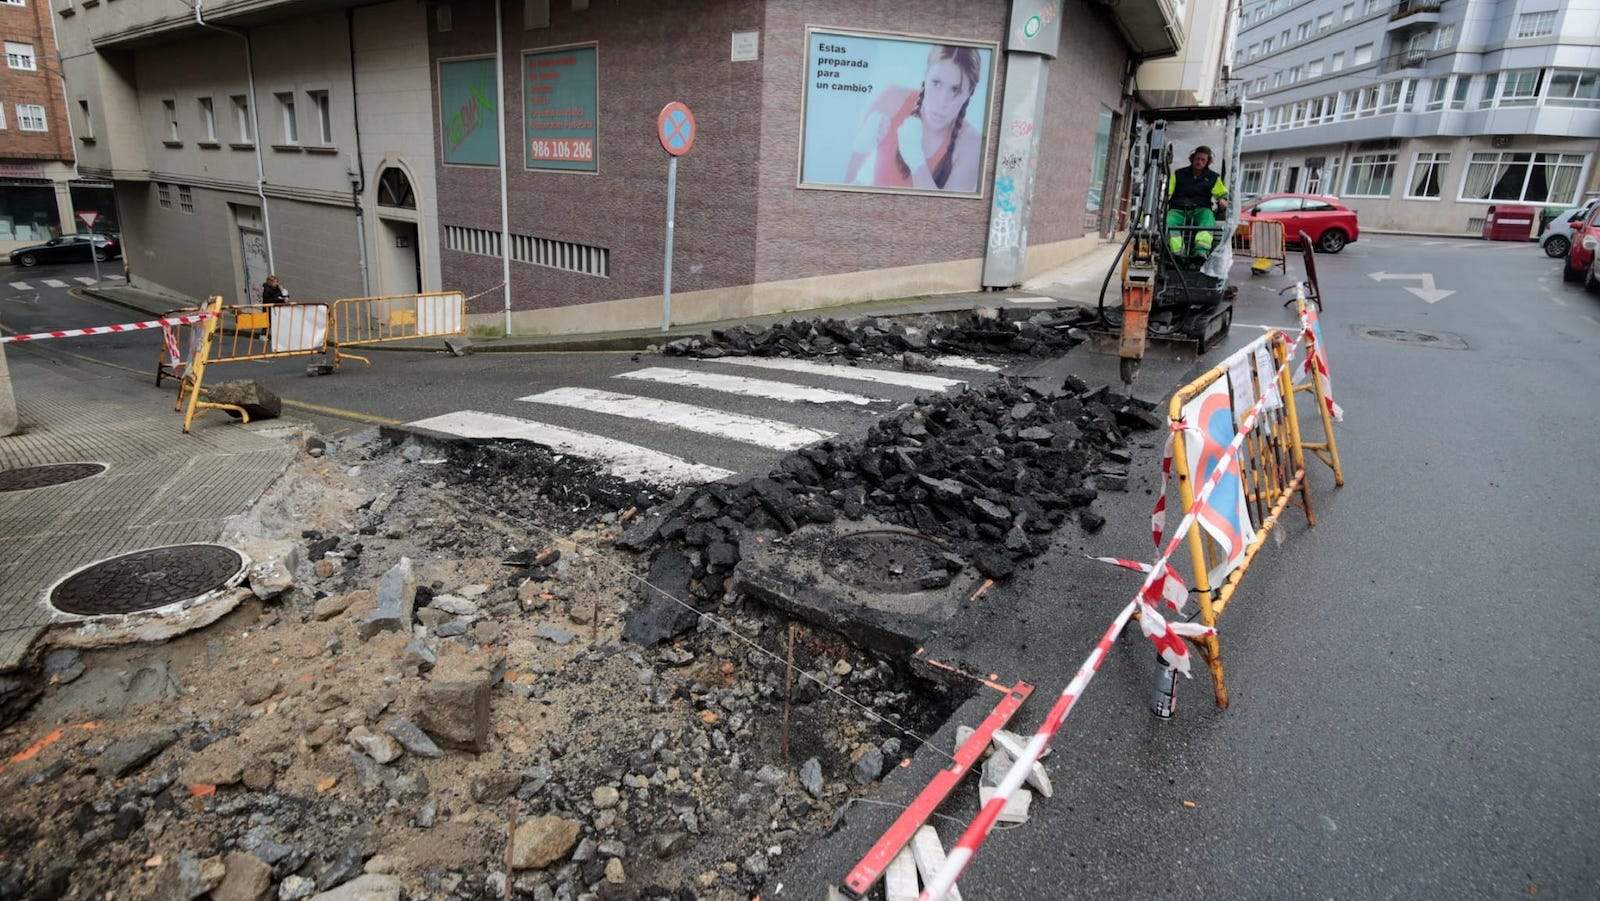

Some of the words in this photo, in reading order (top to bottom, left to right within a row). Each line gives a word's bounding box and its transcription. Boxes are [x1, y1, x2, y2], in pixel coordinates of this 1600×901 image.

[819, 43, 846, 53] Estas
[818, 57, 868, 68] preparada
[817, 70, 839, 78] para
[831, 83, 873, 93] cambio?
[532, 140, 550, 157] 986
[552, 141, 570, 158] 106
[573, 142, 592, 159] 206
